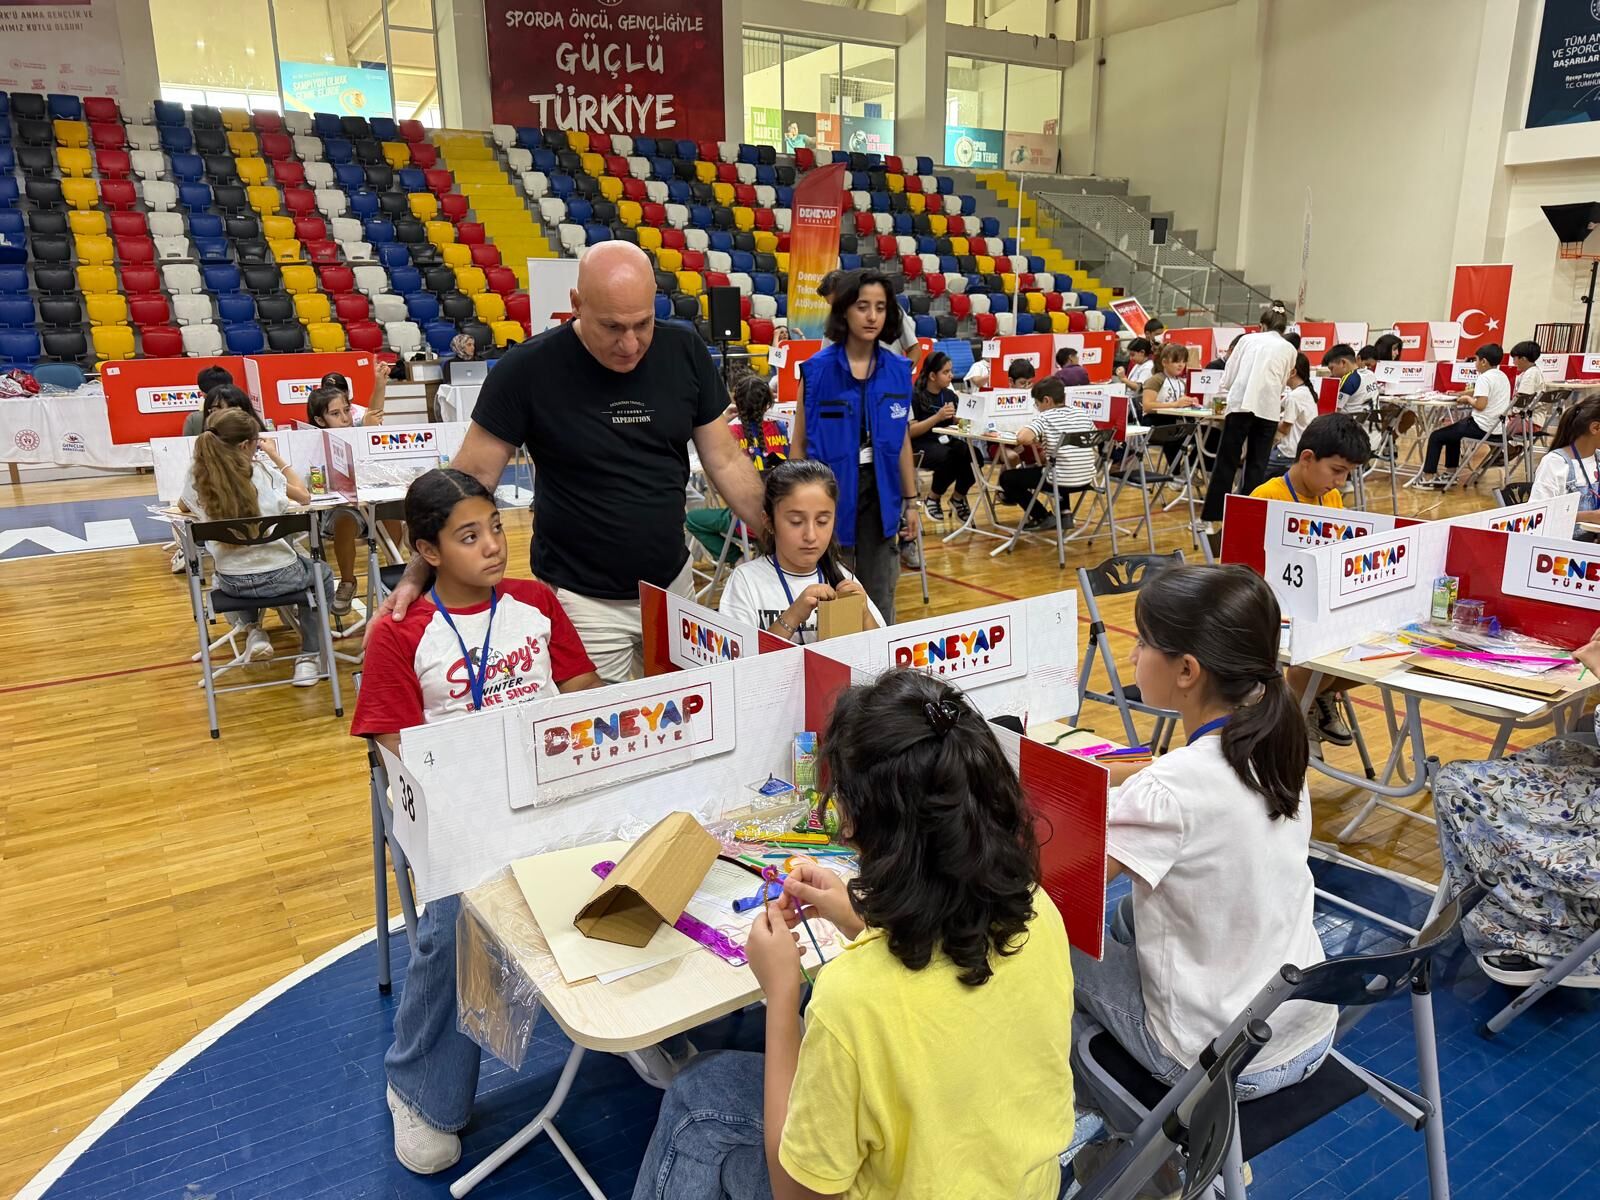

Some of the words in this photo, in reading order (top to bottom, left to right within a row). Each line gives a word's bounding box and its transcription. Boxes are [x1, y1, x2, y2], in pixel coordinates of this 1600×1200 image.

[84, 9, 94, 18] VE
[505, 10, 564, 30] SPORDA
[569, 8, 613, 31] ÖNCÜ,
[618, 12, 704, 33] GENÇLİĞİYLE
[1552, 49, 1564, 59] VE
[1566, 42, 1600, 57] SPORC
[1564, 34, 1587, 48] TÜM
[556, 33, 664, 79] GÜÇLÜ
[1553, 54, 1600, 69] BAŞARILAR
[529, 83, 676, 135] TÜRKİYE
[1200, 376, 1211, 384] 52
[966, 399, 977, 408] 47
[371, 432, 432, 445] DENEYAP
[1287, 517, 1368, 540] DENEYAP
[1344, 545, 1406, 577] DENEYAP
[1282, 563, 1304, 588] 43
[682, 618, 740, 660] DENEYAP
[895, 625, 1005, 668] DENEYAP
[926, 655, 990, 675] ÜRKİYE
[506, 682, 540, 700] SHOP
[544, 694, 704, 757] DENEYAP
[424, 751, 436, 765] 4
[573, 730, 683, 766] TÜRKİYE
[399, 775, 416, 822] 38
